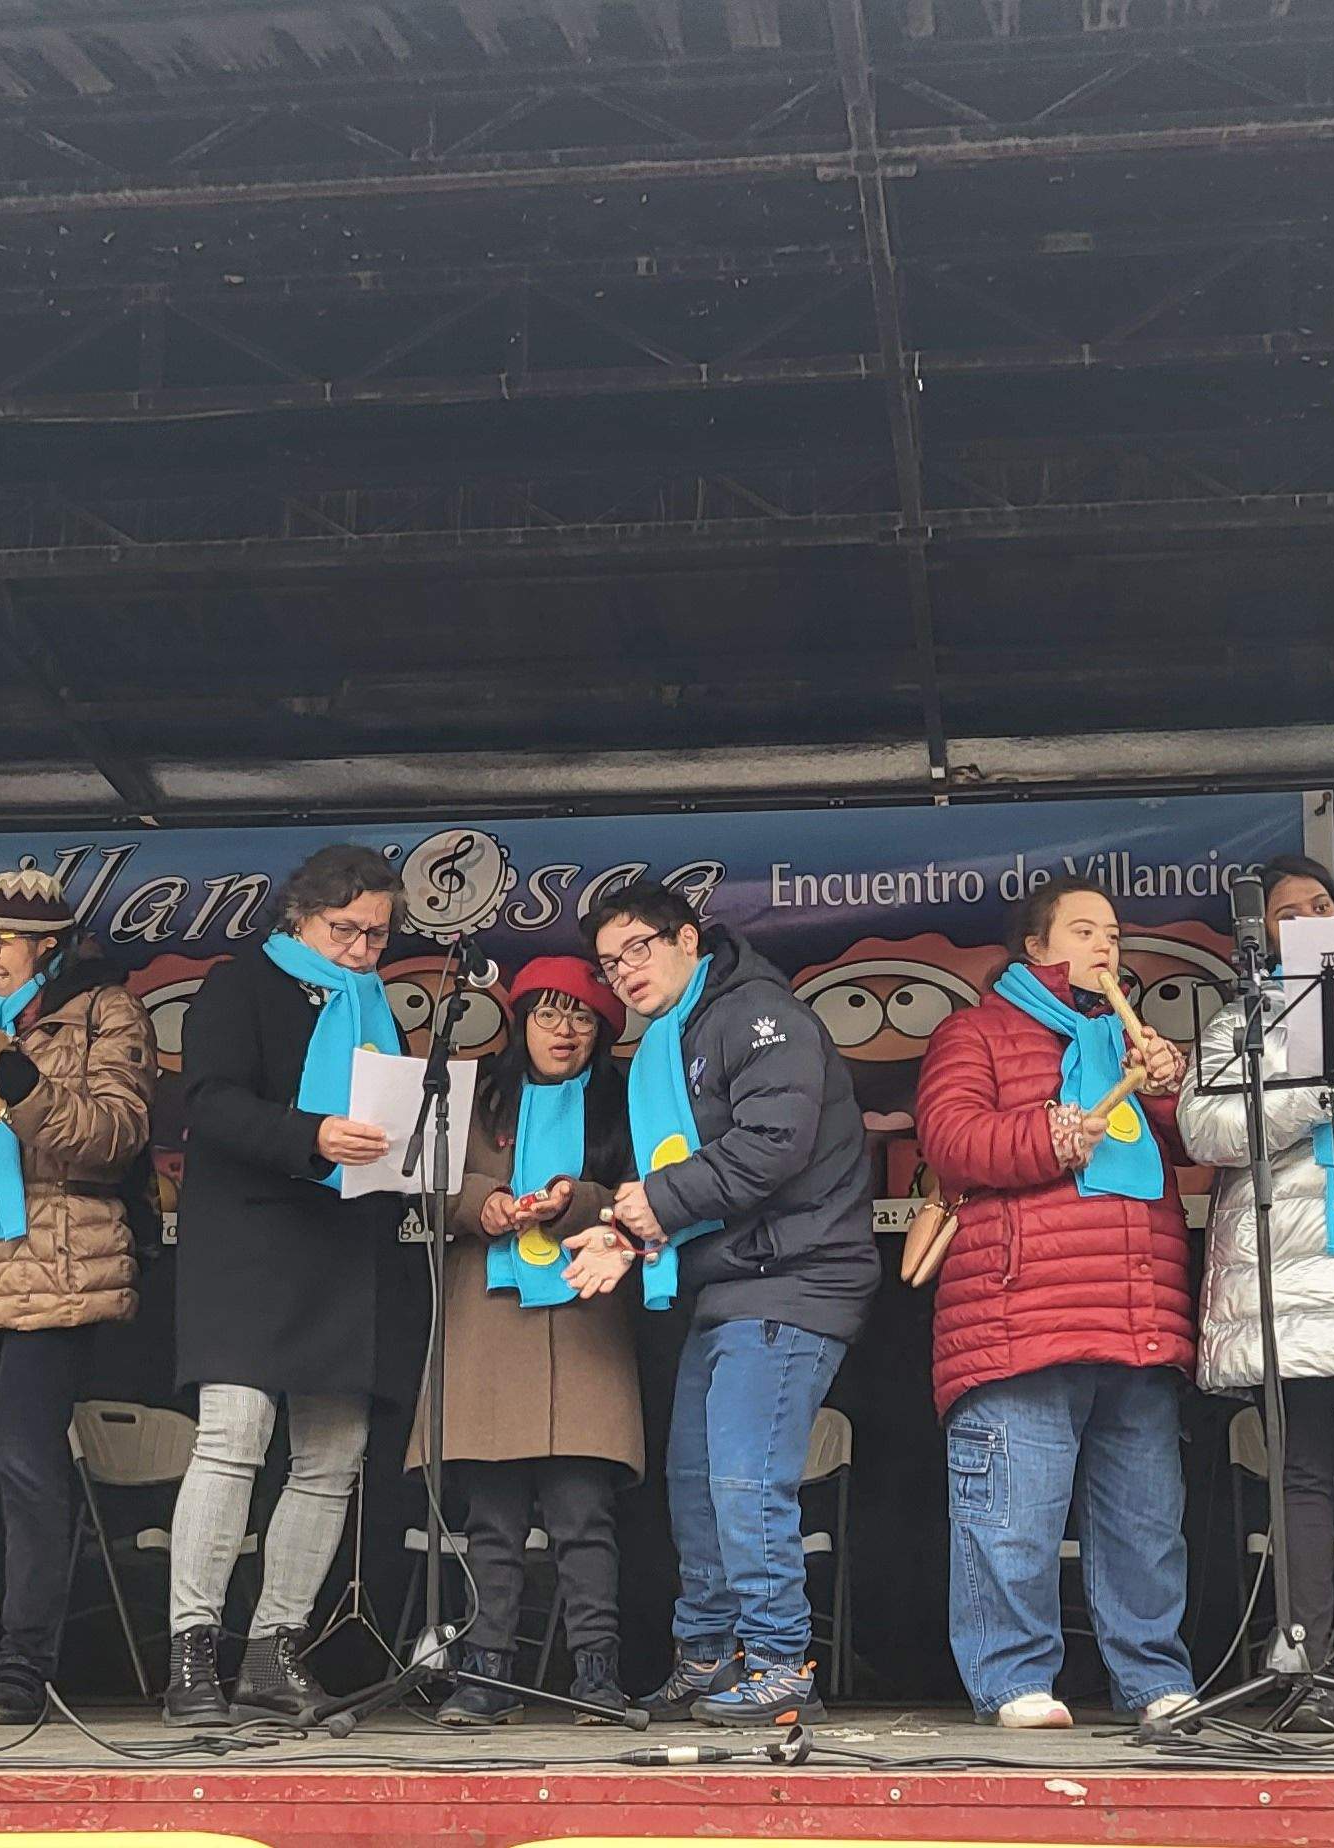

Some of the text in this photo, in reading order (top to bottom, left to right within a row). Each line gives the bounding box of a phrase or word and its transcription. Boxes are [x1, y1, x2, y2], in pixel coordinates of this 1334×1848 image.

[771, 862, 985, 907] Encuentro
[999, 853, 1052, 902] de
[751, 1033, 787, 1050] KELME
